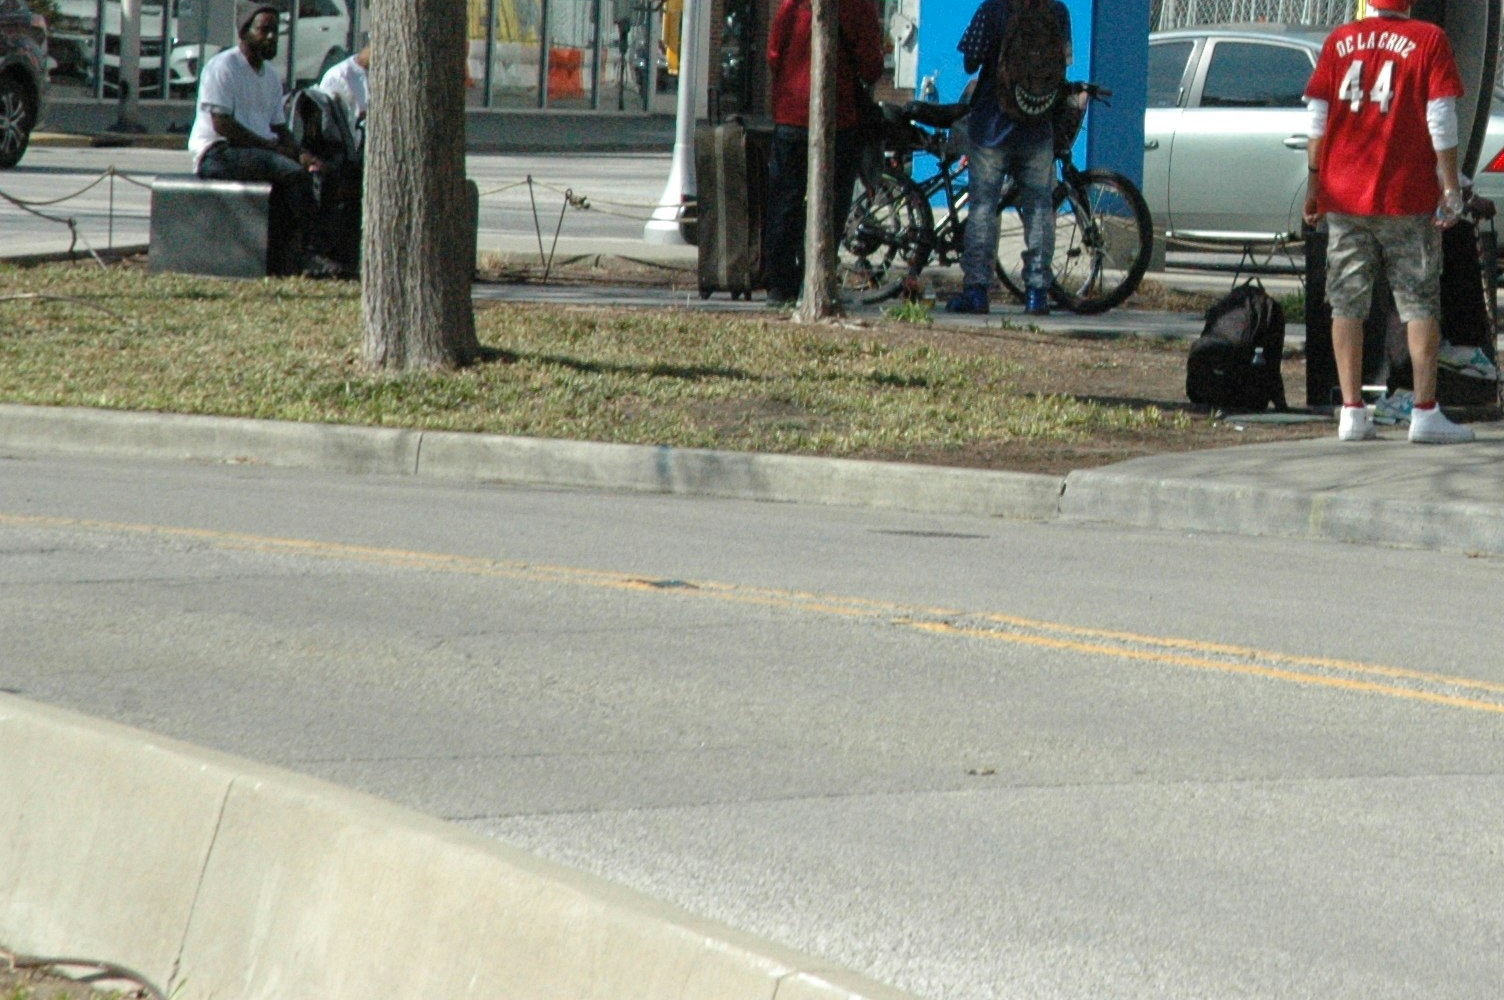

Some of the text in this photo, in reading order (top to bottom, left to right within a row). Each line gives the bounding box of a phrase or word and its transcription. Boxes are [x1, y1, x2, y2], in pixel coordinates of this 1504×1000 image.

[1336, 31, 1417, 59] DE LA CRUZ
[1338, 59, 1394, 114] 44
